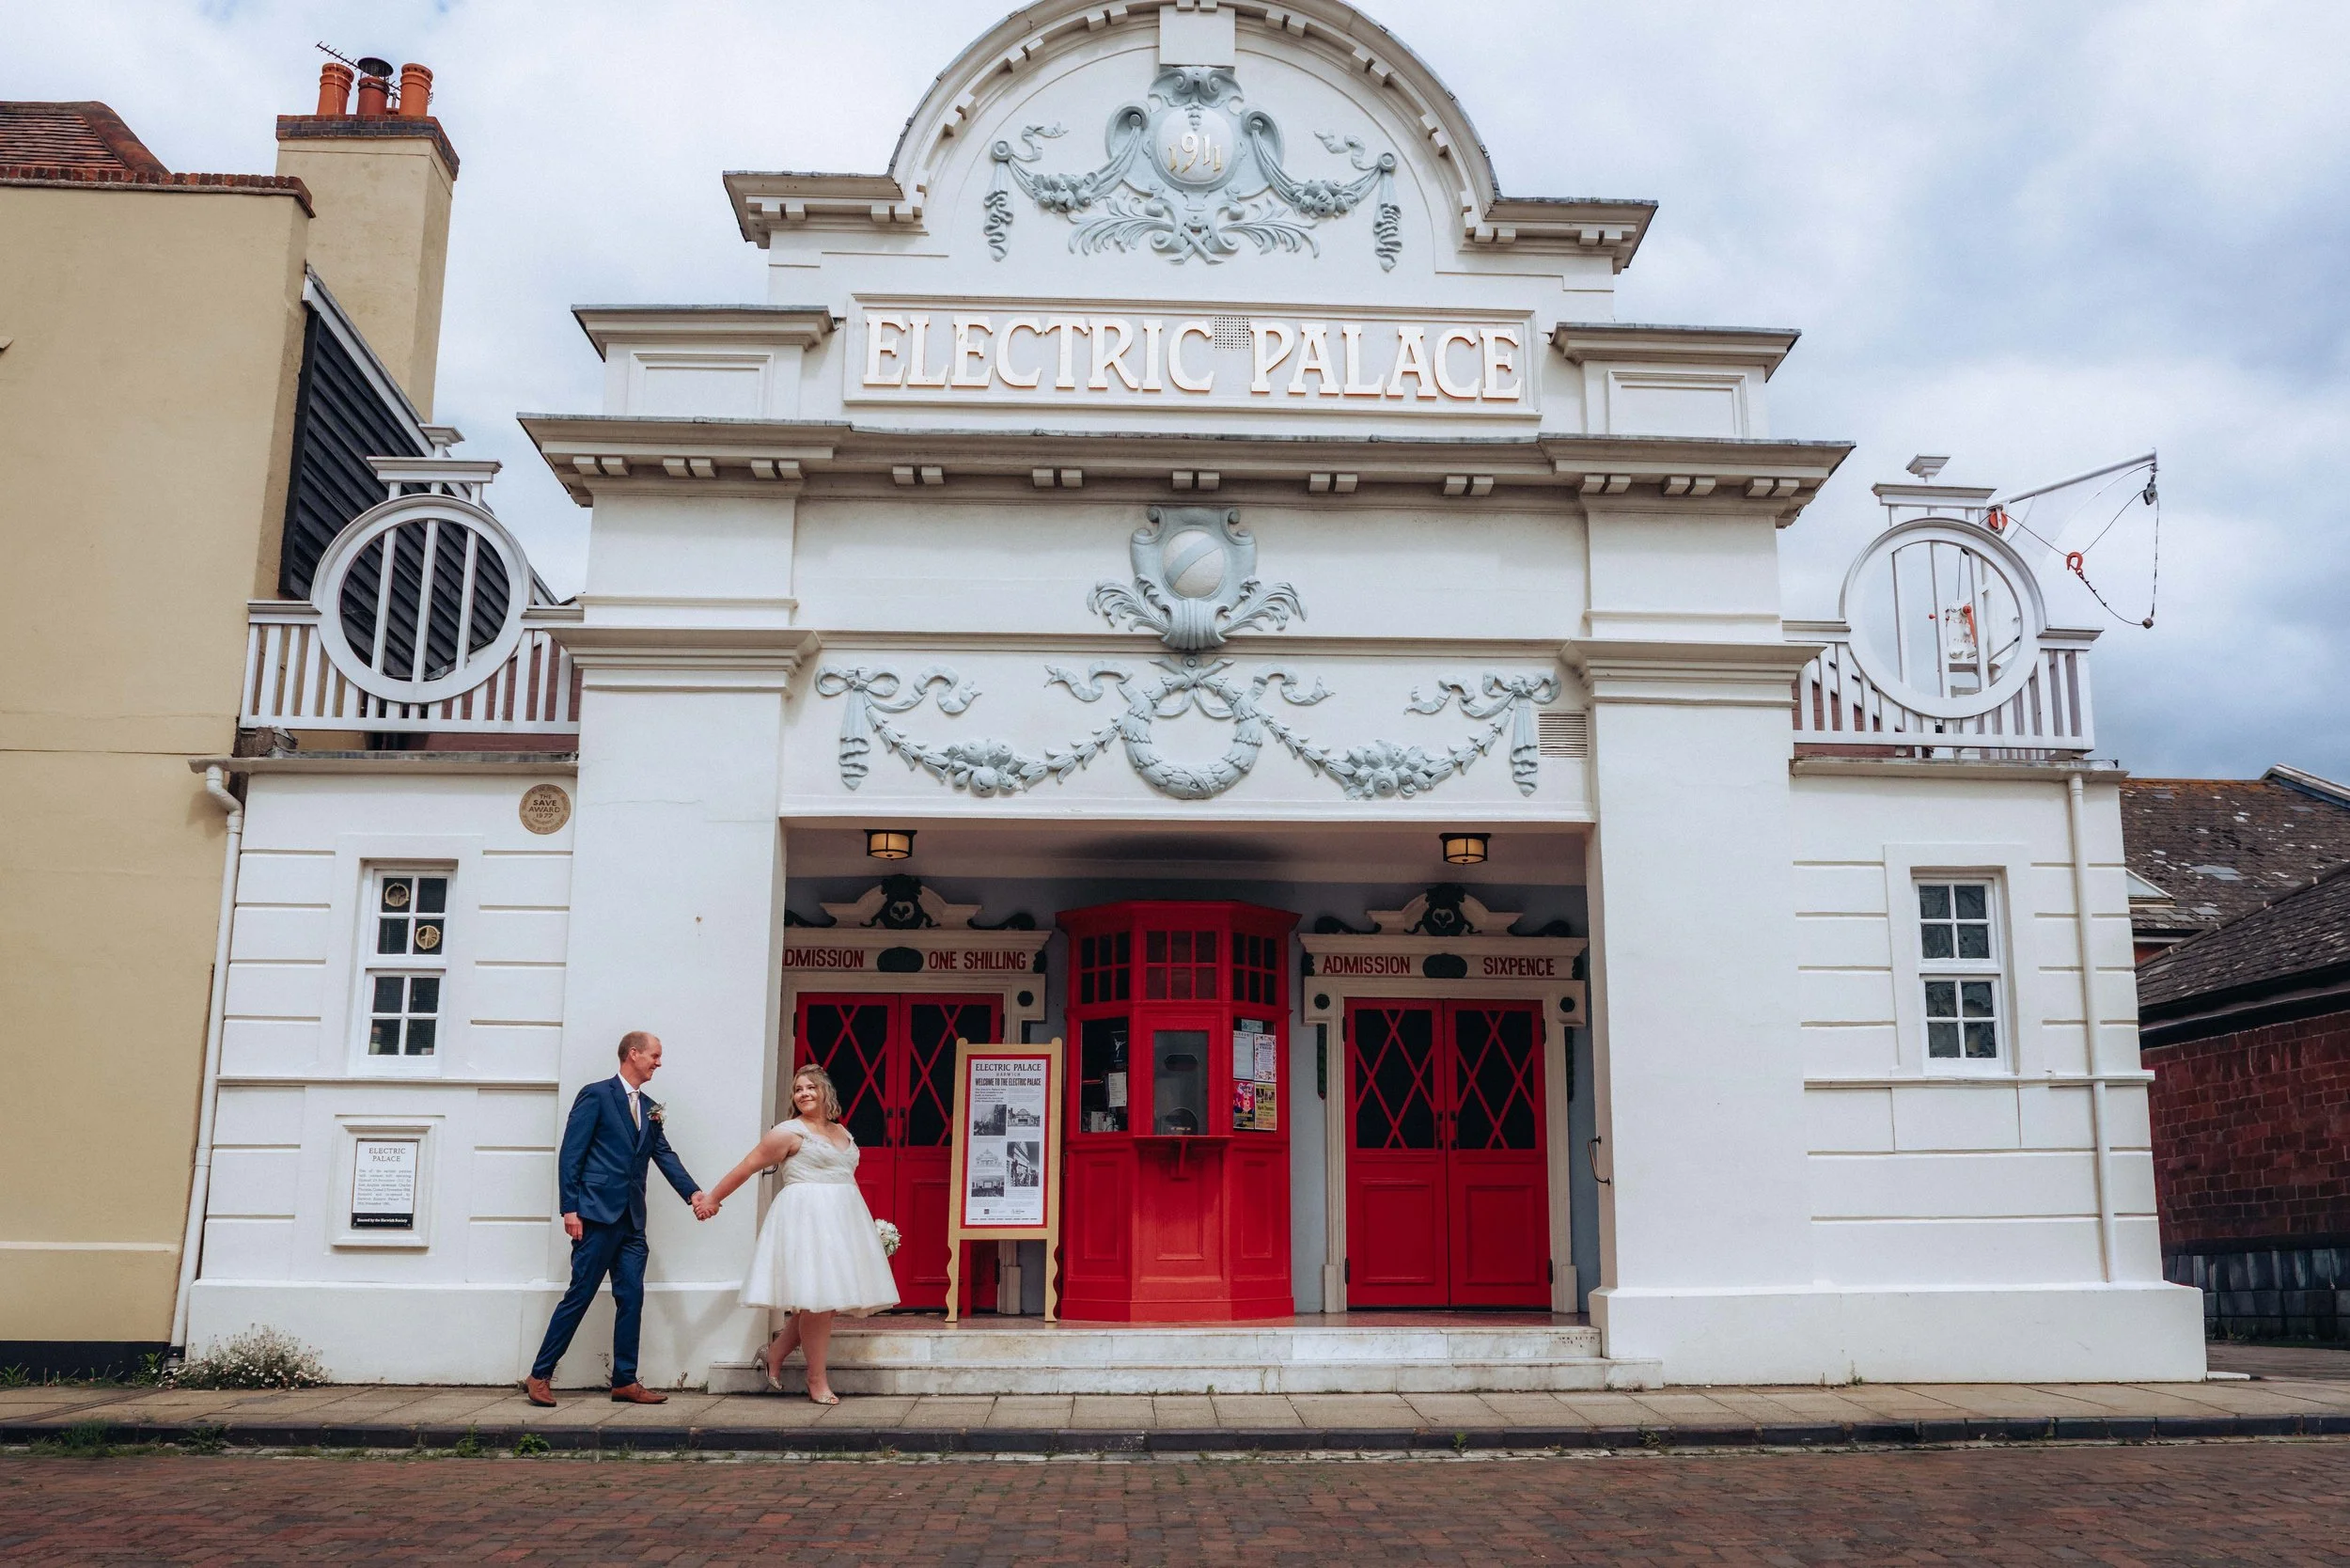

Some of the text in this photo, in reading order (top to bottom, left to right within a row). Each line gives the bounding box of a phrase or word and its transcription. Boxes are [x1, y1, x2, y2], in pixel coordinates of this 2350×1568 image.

[1168, 131, 1222, 173] 1911
[863, 314, 1523, 400] ELECTRIC PALACE
[783, 949, 865, 968] DMISSION
[929, 950, 1026, 970] ONE SHILLING
[1323, 955, 1410, 974] ADMISSION
[1483, 957, 1556, 976] SIXPENCE
[1013, 1063, 1042, 1072] PALACE
[975, 1077, 995, 1086] WELCOME
[1000, 1077, 1009, 1086] THE
[1009, 1077, 1026, 1086] ELECTRIC
[1026, 1077, 1042, 1086] PALACE
